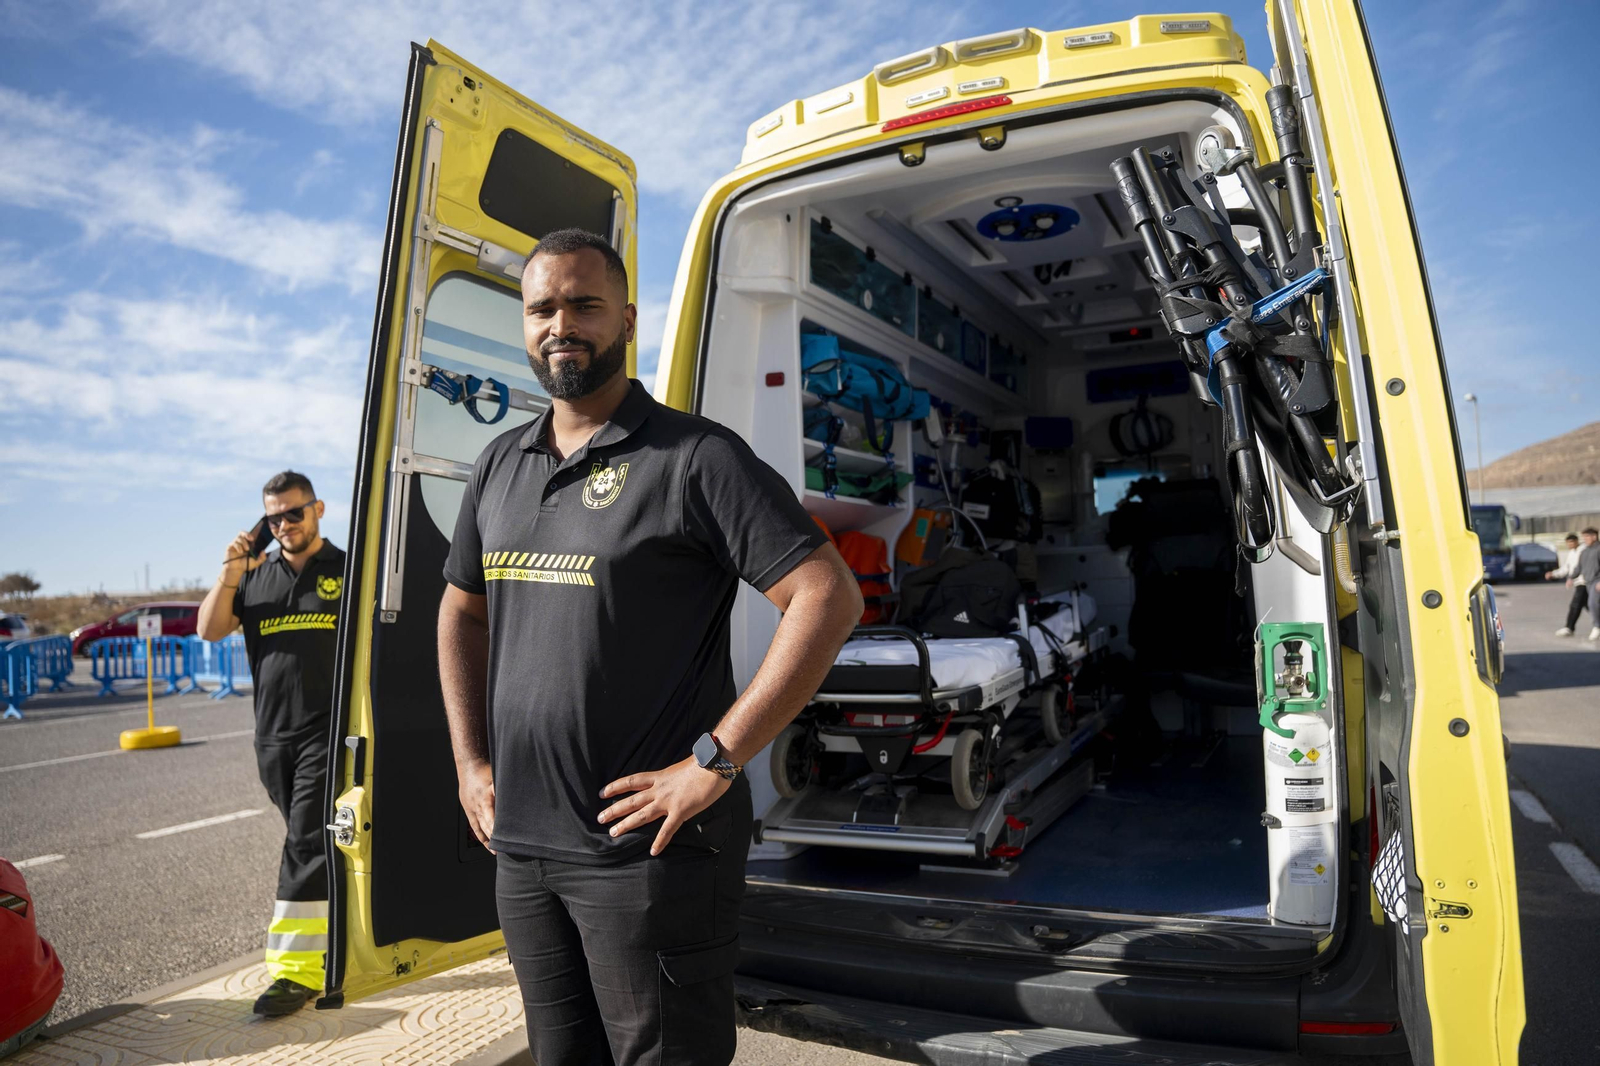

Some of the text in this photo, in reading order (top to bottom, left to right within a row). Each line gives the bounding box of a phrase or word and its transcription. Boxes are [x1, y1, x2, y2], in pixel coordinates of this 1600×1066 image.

[598, 477, 609, 485] 24
[485, 570, 555, 581] ERVICIOS SANITARIOS
